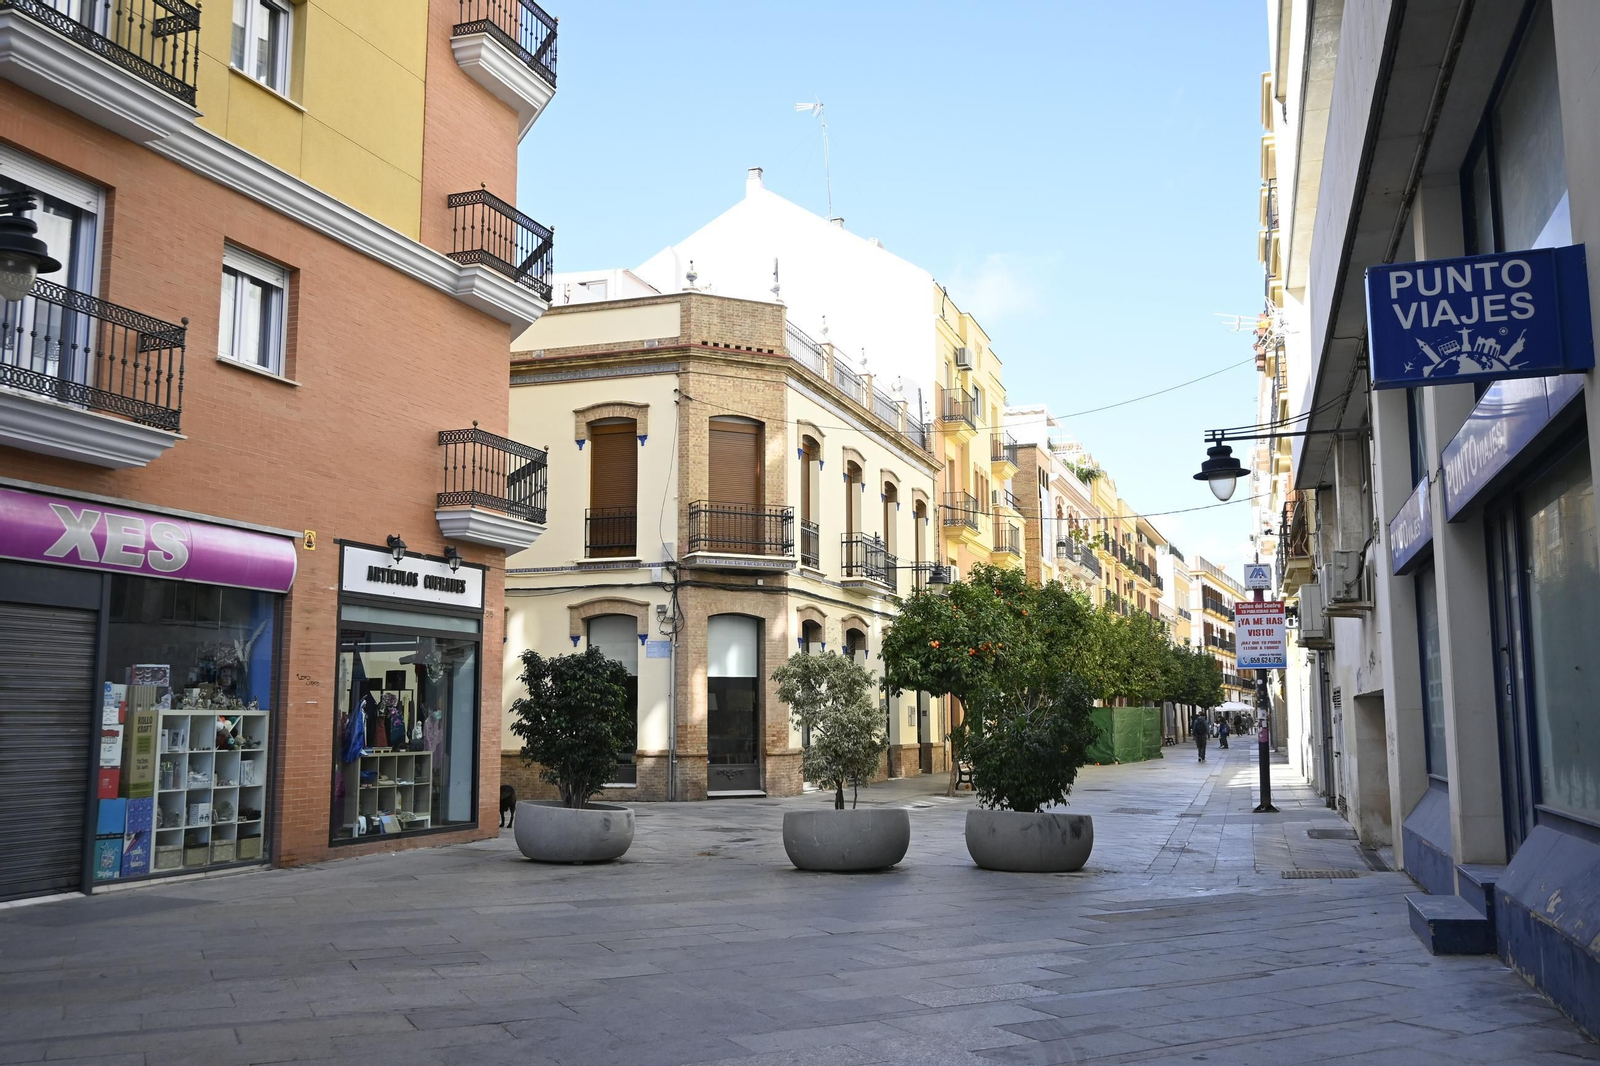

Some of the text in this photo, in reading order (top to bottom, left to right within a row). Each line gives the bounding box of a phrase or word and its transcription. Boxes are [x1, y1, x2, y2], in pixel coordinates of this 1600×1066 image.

[1389, 259, 1532, 299] PUNTO
[1392, 292, 1535, 330] VIAJES
[44, 503, 189, 572] XES
[367, 564, 466, 594] ARTÍCULOS COFRADES
[1238, 617, 1283, 628] ¡YA ME HAS
[1247, 628, 1274, 637] VISTO!
